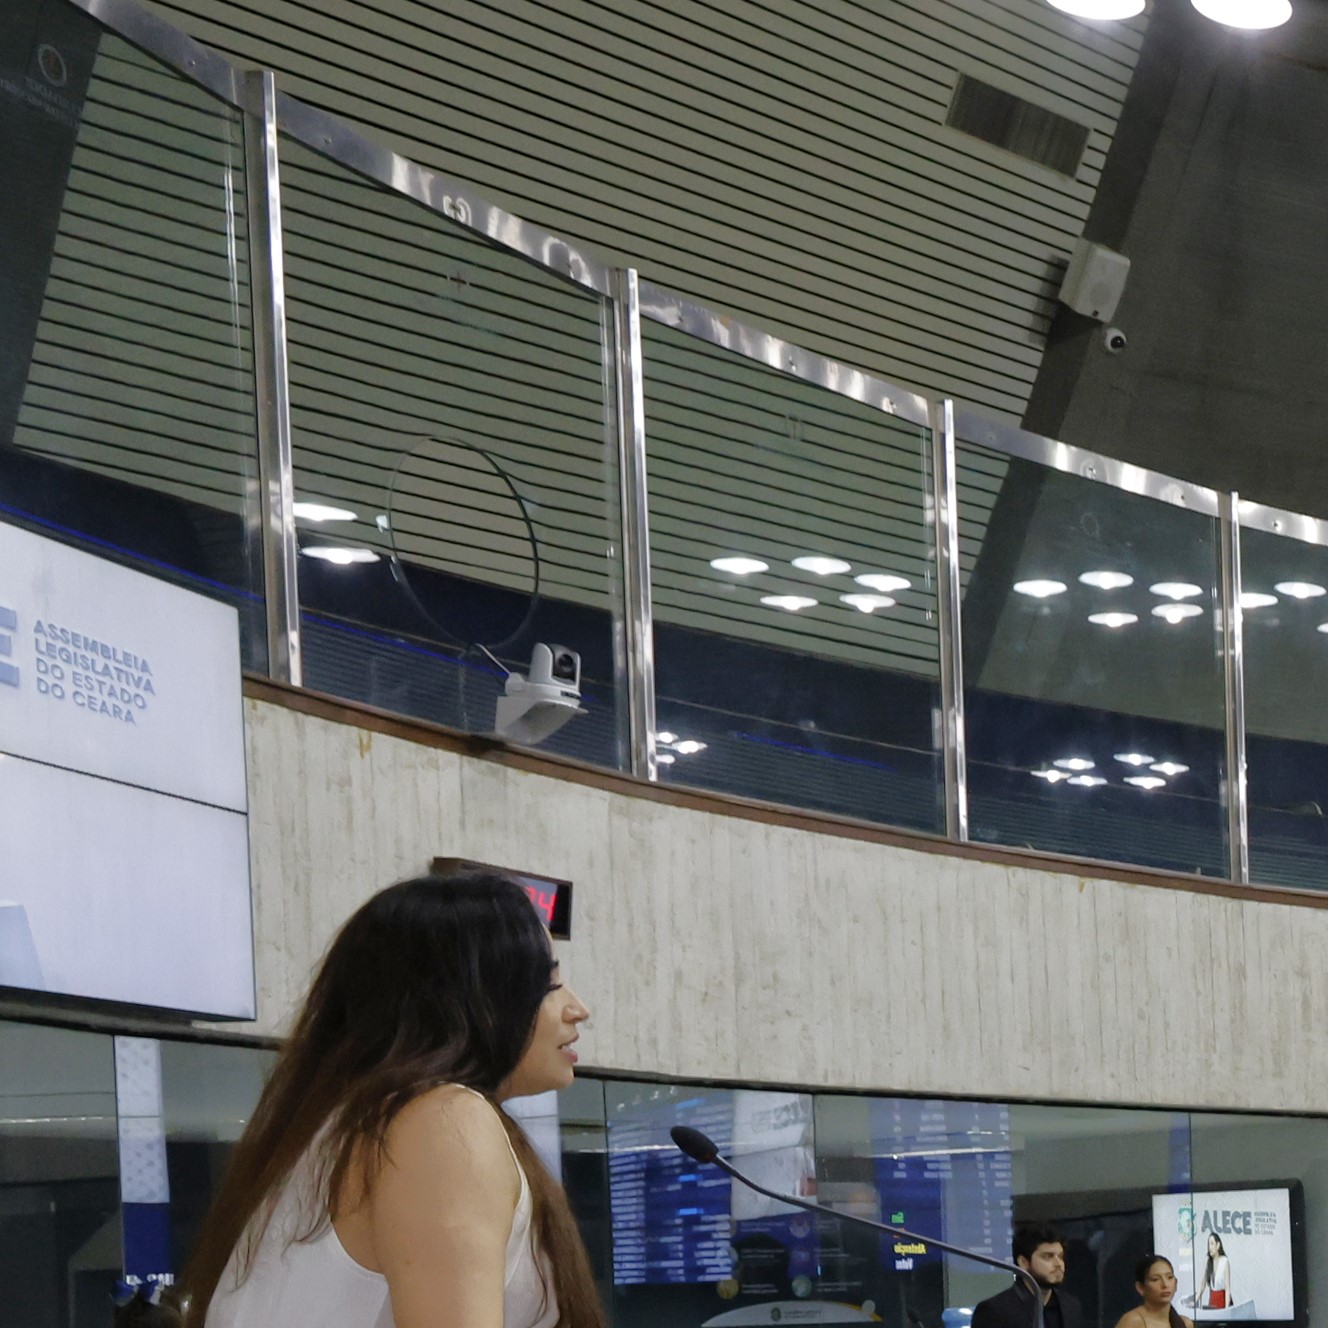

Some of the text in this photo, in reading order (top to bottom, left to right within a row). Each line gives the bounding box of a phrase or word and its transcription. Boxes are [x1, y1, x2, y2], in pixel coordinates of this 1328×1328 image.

[34, 619, 153, 676] ASSEMBLEIA
[35, 638, 156, 695] LEGISLATIVA
[36, 658, 146, 709] DO ESTADO
[37, 677, 65, 699] DO
[1201, 1210, 1252, 1235] ALECE
